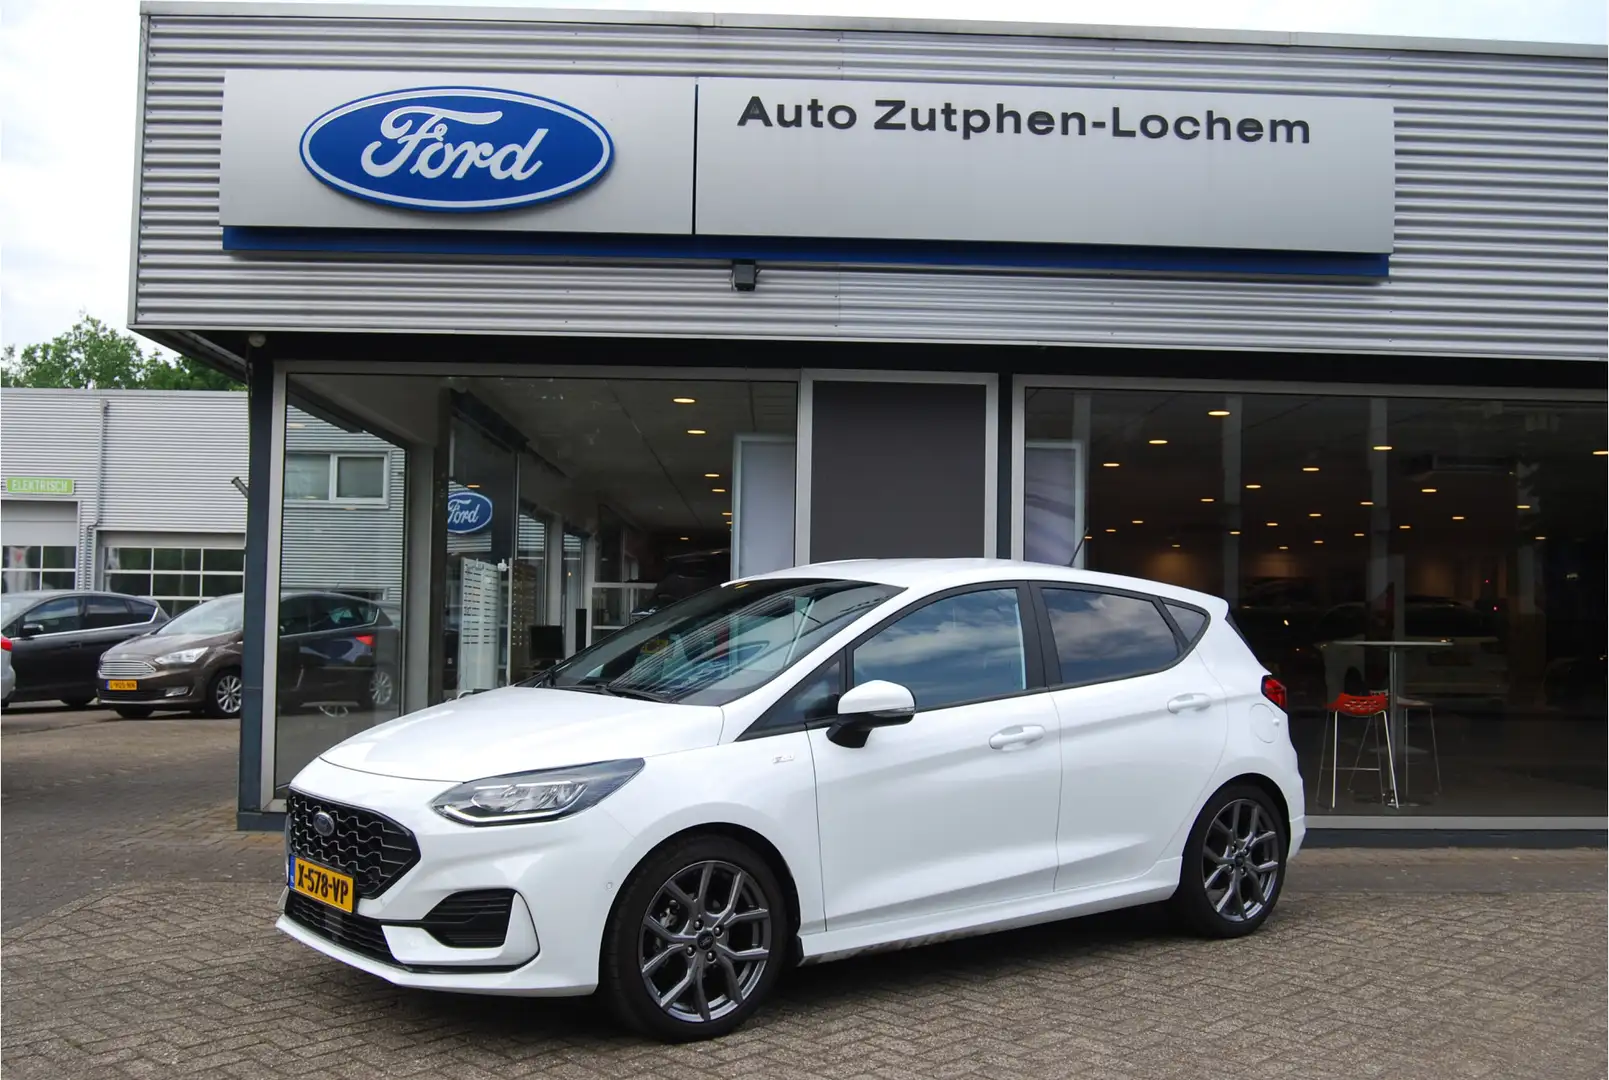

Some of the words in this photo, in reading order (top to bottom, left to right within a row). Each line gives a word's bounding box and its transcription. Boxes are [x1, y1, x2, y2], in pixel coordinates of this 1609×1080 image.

[737, 95, 858, 130] Auto
[873, 99, 1311, 144] Zutphen-Lochem
[361, 105, 549, 181] Ford
[11, 479, 69, 492] ELEKTRISCH
[447, 498, 481, 524] Ford
[297, 863, 349, 905] X-578-VP
